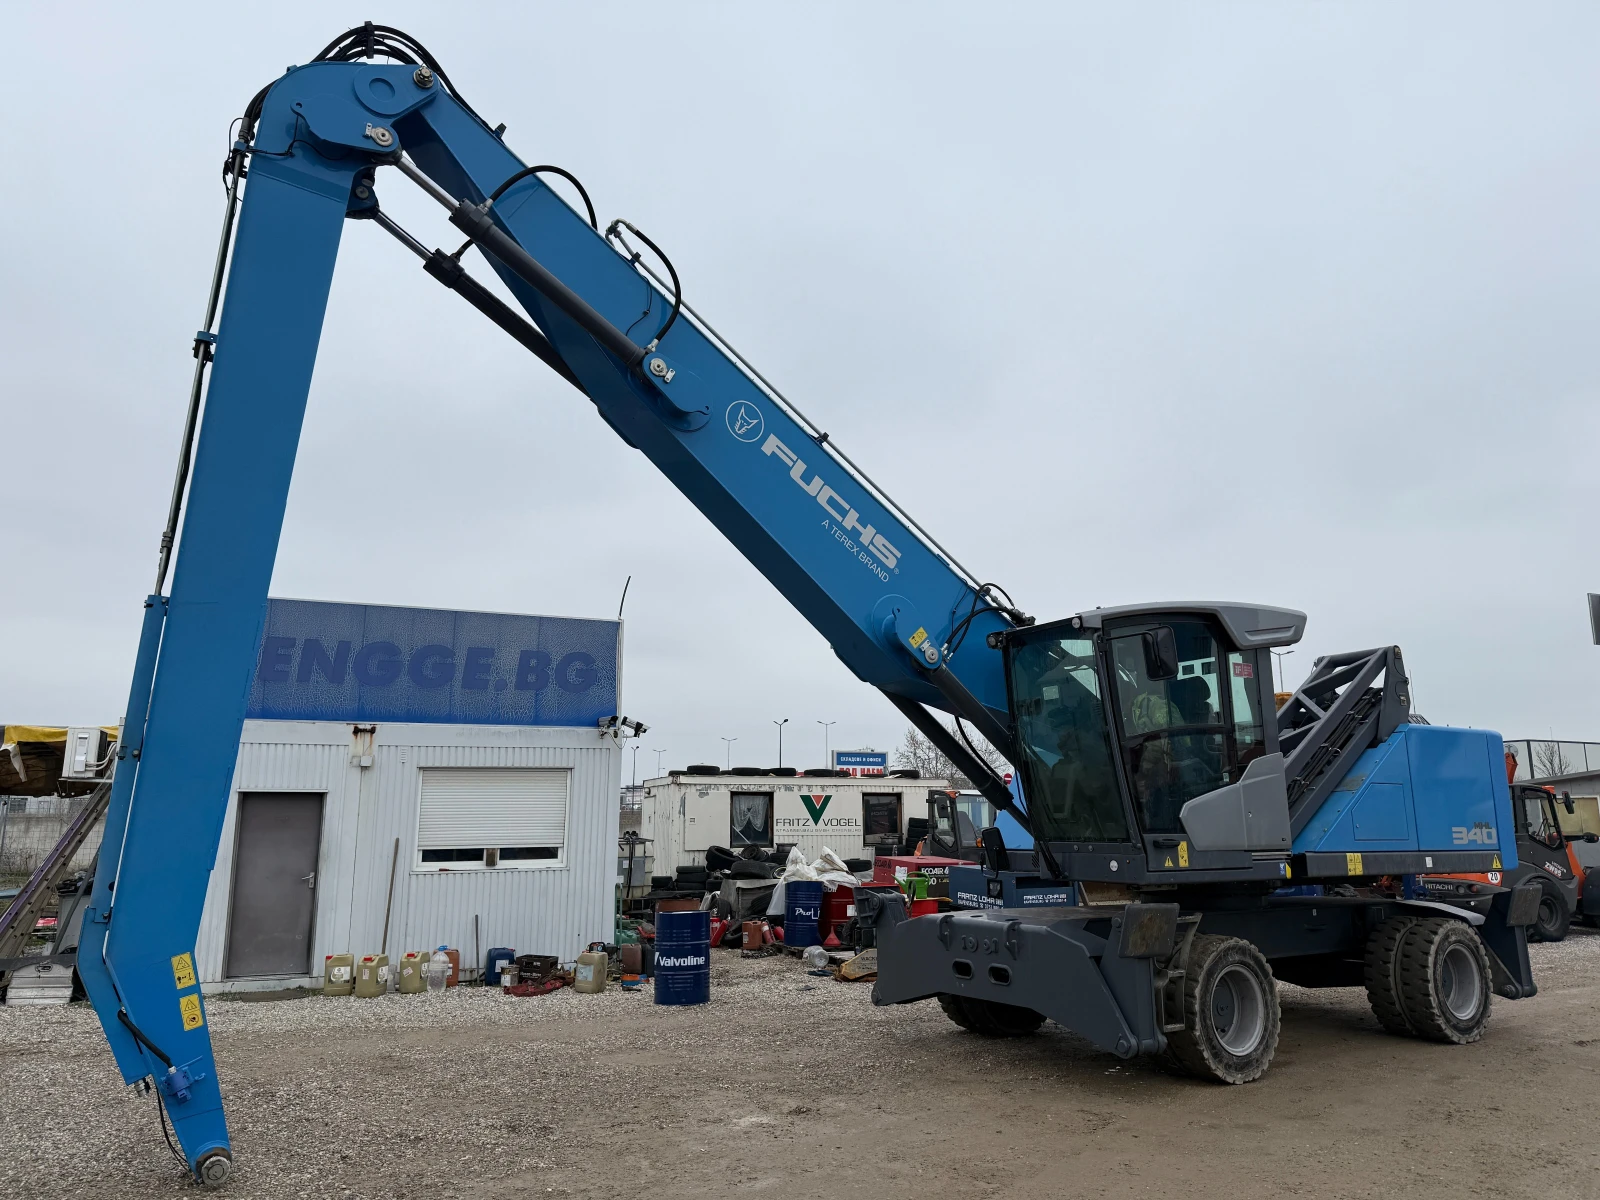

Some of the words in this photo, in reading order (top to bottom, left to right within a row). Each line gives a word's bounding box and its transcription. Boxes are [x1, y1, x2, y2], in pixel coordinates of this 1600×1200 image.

[761, 433, 901, 569] FUCHS
[821, 519, 829, 529] A
[831, 524, 859, 556] TEREX
[859, 551, 889, 582] BRAND
[258, 636, 597, 694] ENGGE.BG
[775, 818, 811, 827] FRITZ
[822, 818, 862, 827] VOGEL
[1474, 822, 1492, 830] MHL
[1452, 827, 1497, 844] 340
[1490, 872, 1499, 881] 20
[659, 955, 706, 967] Valvoline
